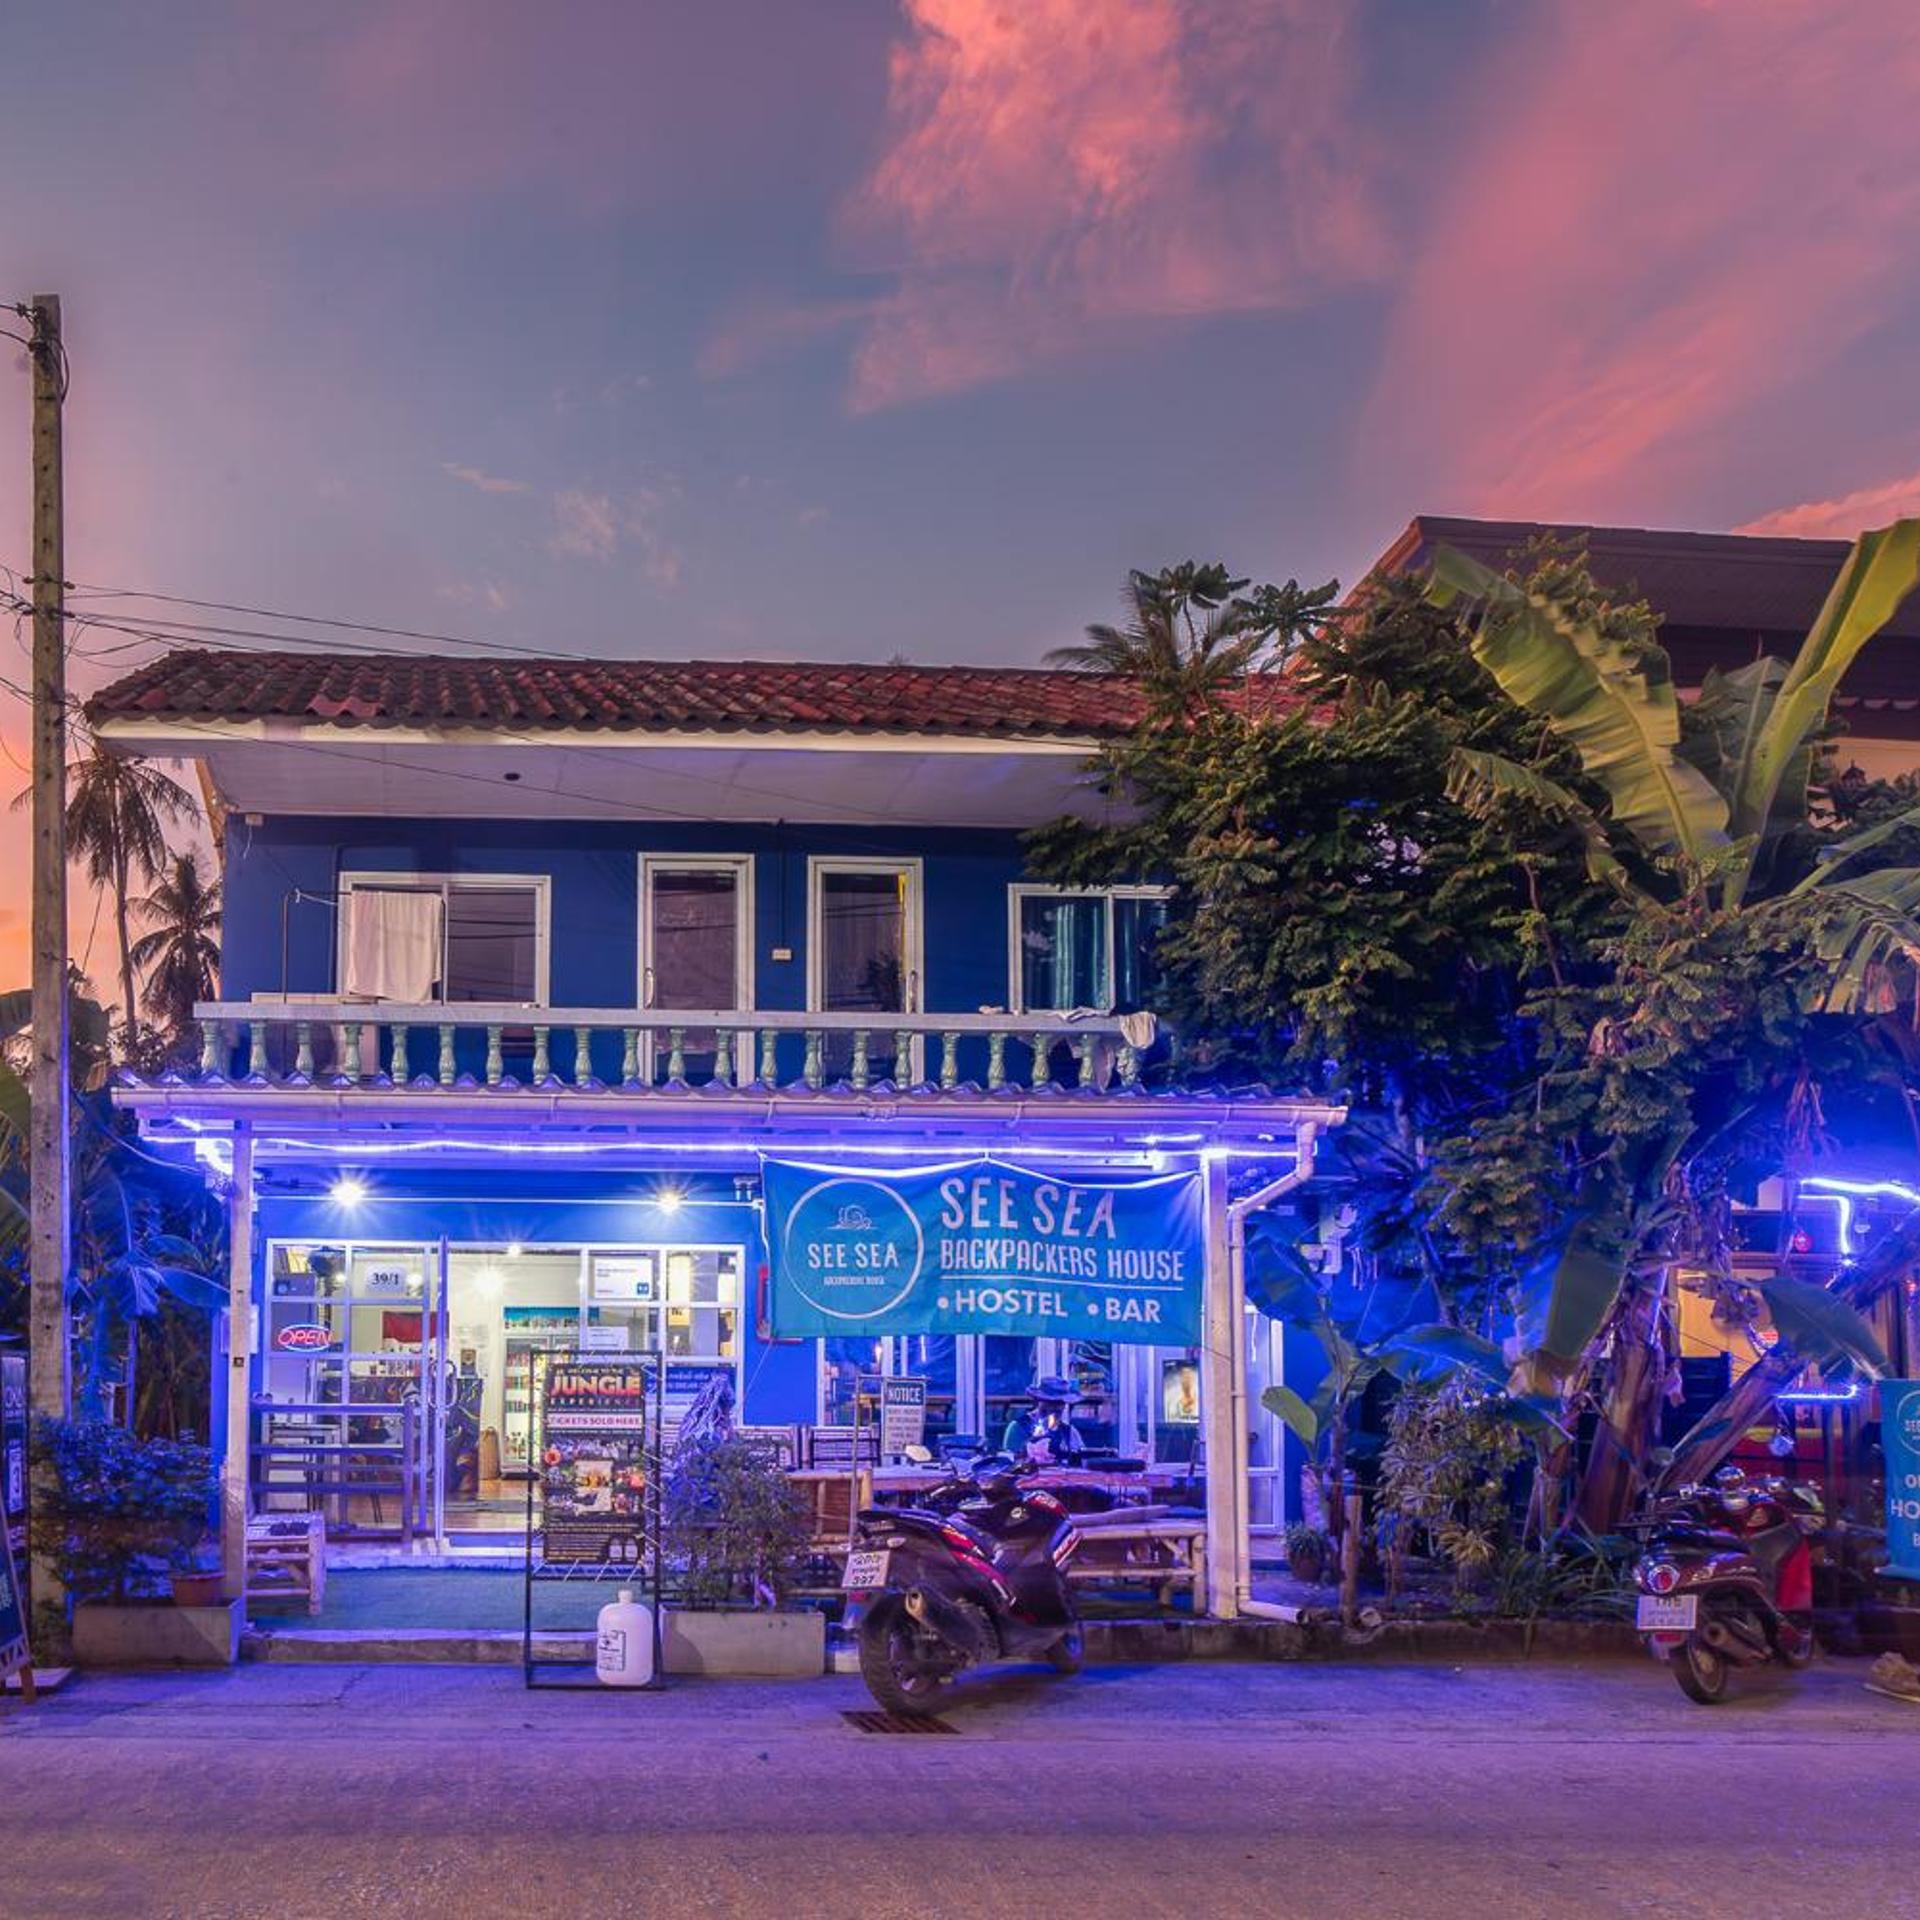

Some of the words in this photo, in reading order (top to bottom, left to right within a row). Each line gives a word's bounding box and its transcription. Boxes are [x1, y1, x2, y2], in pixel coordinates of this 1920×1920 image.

[939, 1178, 1019, 1229] SEE
[1032, 1182, 1117, 1240] SEA
[807, 1243, 847, 1269] SEE
[854, 1242, 899, 1269] SEA
[940, 1239, 1098, 1278] BACKPACKERS
[1107, 1249, 1185, 1282] HOUSE
[371, 1272, 400, 1286] 39/1
[955, 1288, 1068, 1317] HOSTEL
[1105, 1298, 1161, 1323] BAR
[278, 1329, 335, 1346] OPEN
[550, 1375, 641, 1396] JUNGLE
[887, 1387, 921, 1403] NOTICE
